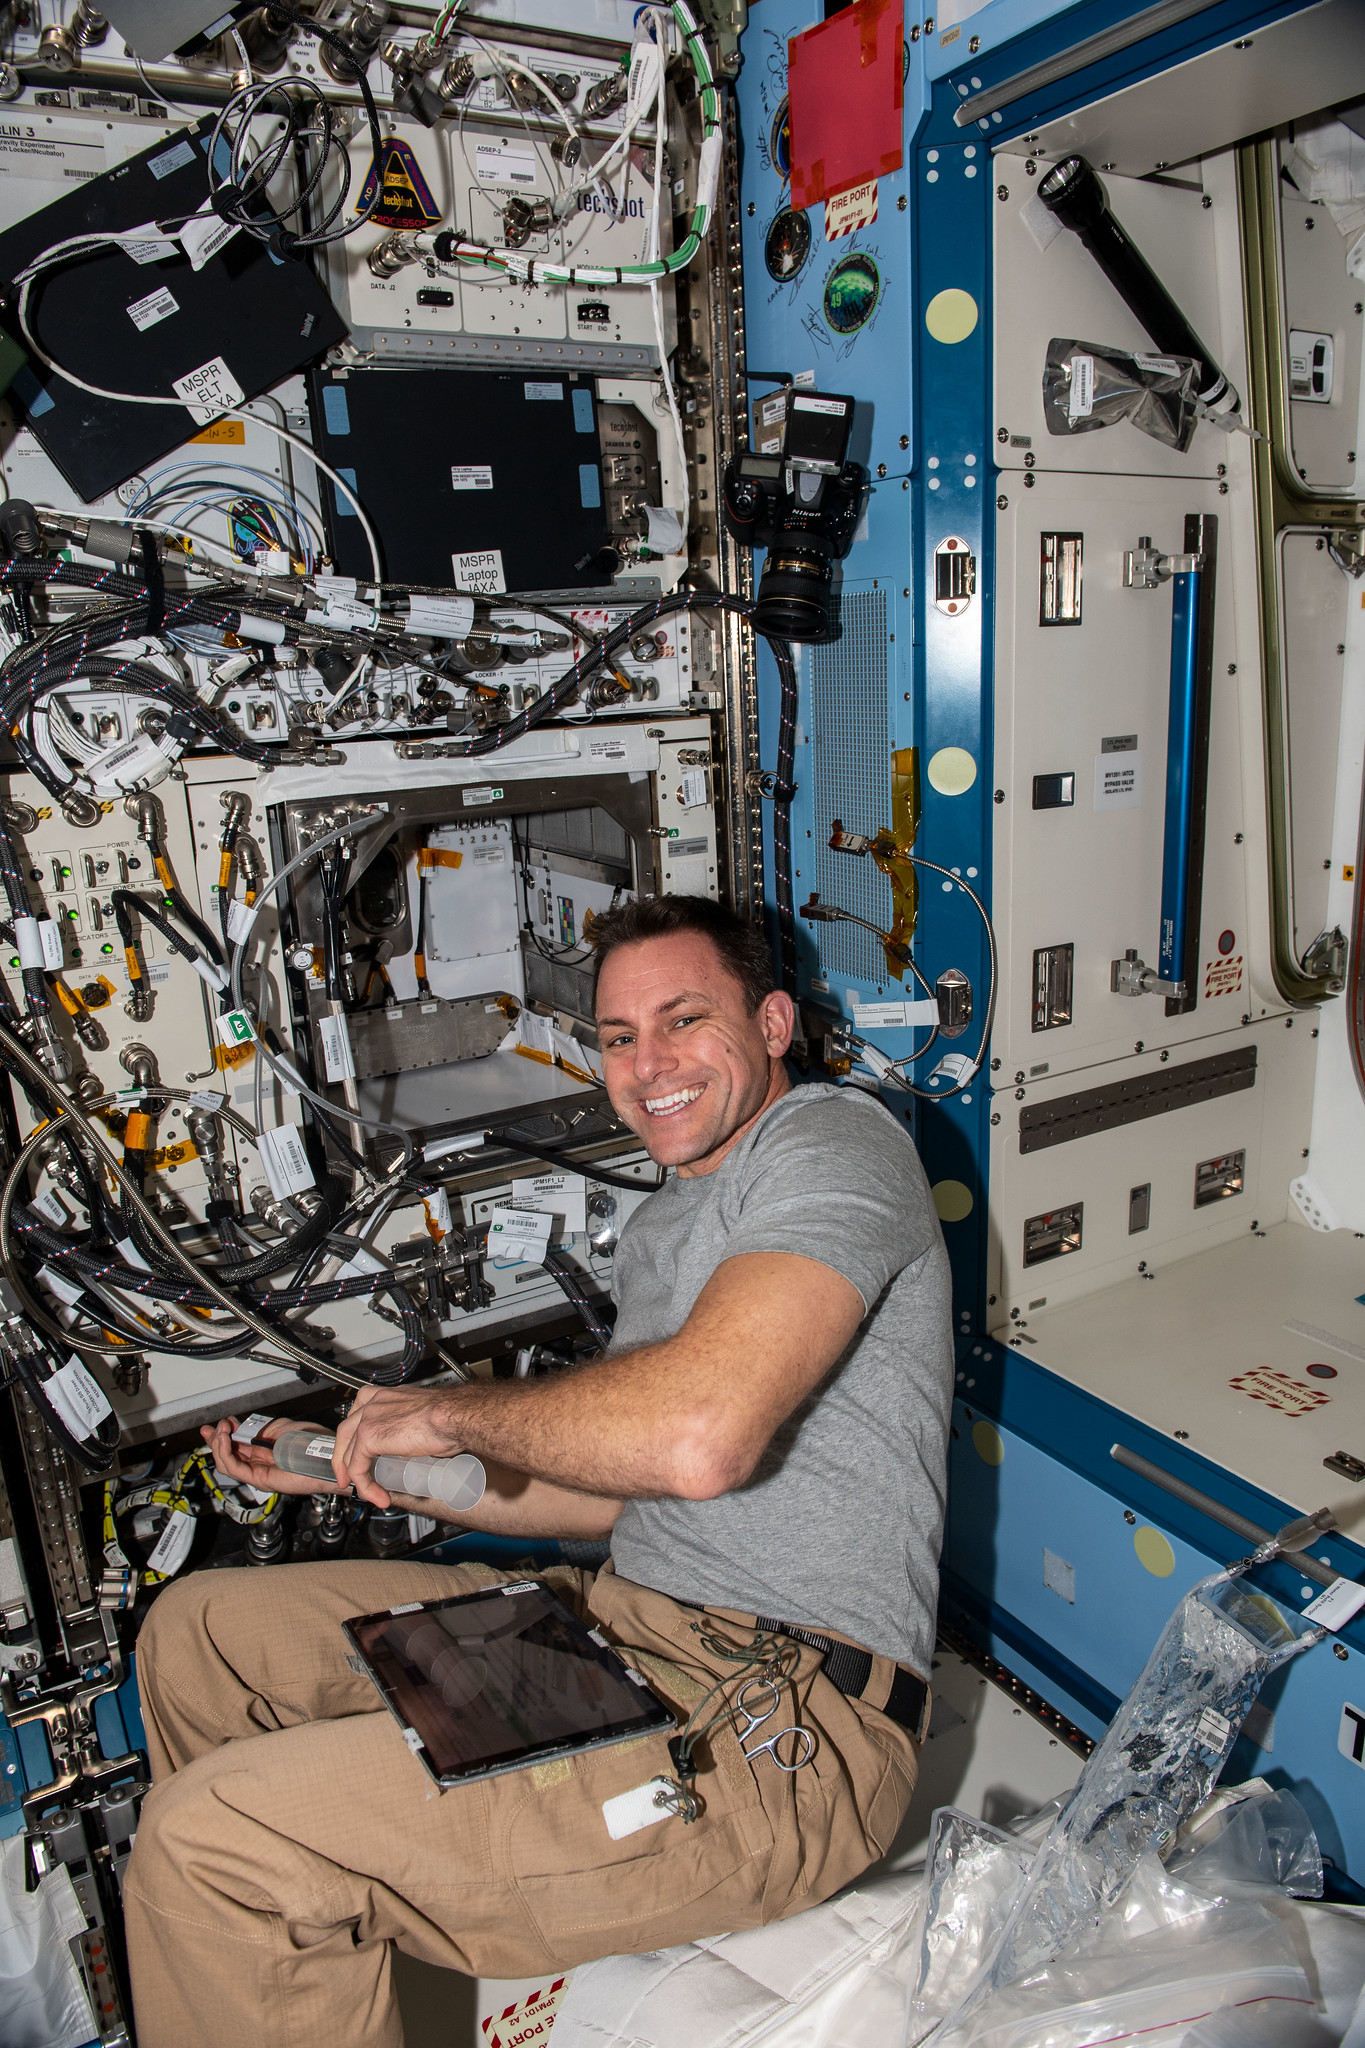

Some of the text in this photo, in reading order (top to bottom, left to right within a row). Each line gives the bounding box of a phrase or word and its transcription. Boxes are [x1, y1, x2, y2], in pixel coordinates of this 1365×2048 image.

[580, 71, 601, 79] LOCKER
[26, 127, 35, 137] 3
[20, 141, 56, 150] Experiment
[477, 146, 502, 154] ADSEP-2
[496, 188, 520, 196] POWER
[384, 194, 413, 208] techshot
[832, 185, 870, 212] FIRE PORT
[370, 214, 428, 227] PROCESSOR
[831, 291, 842, 308] 49
[181, 364, 222, 394] MSPR
[196, 380, 222, 403] ELT
[610, 423, 638, 434] techshot
[792, 508, 822, 517] Nikon
[460, 554, 496, 568] MSPR
[460, 569, 498, 582] Laptop
[482, 834, 487, 842] 3
[70, 932, 109, 942] INDICATORS
[1210, 972, 1238, 984] FIRE PORT
[532, 1176, 566, 1186] JPM1F1_L2
[1250, 1378, 1308, 1405] FIRE PORT
[1262, 1372, 1318, 1400] EMERGENCY USE
[508, 1584, 532, 1594] JOSH
[508, 2022, 544, 2048] PORT
